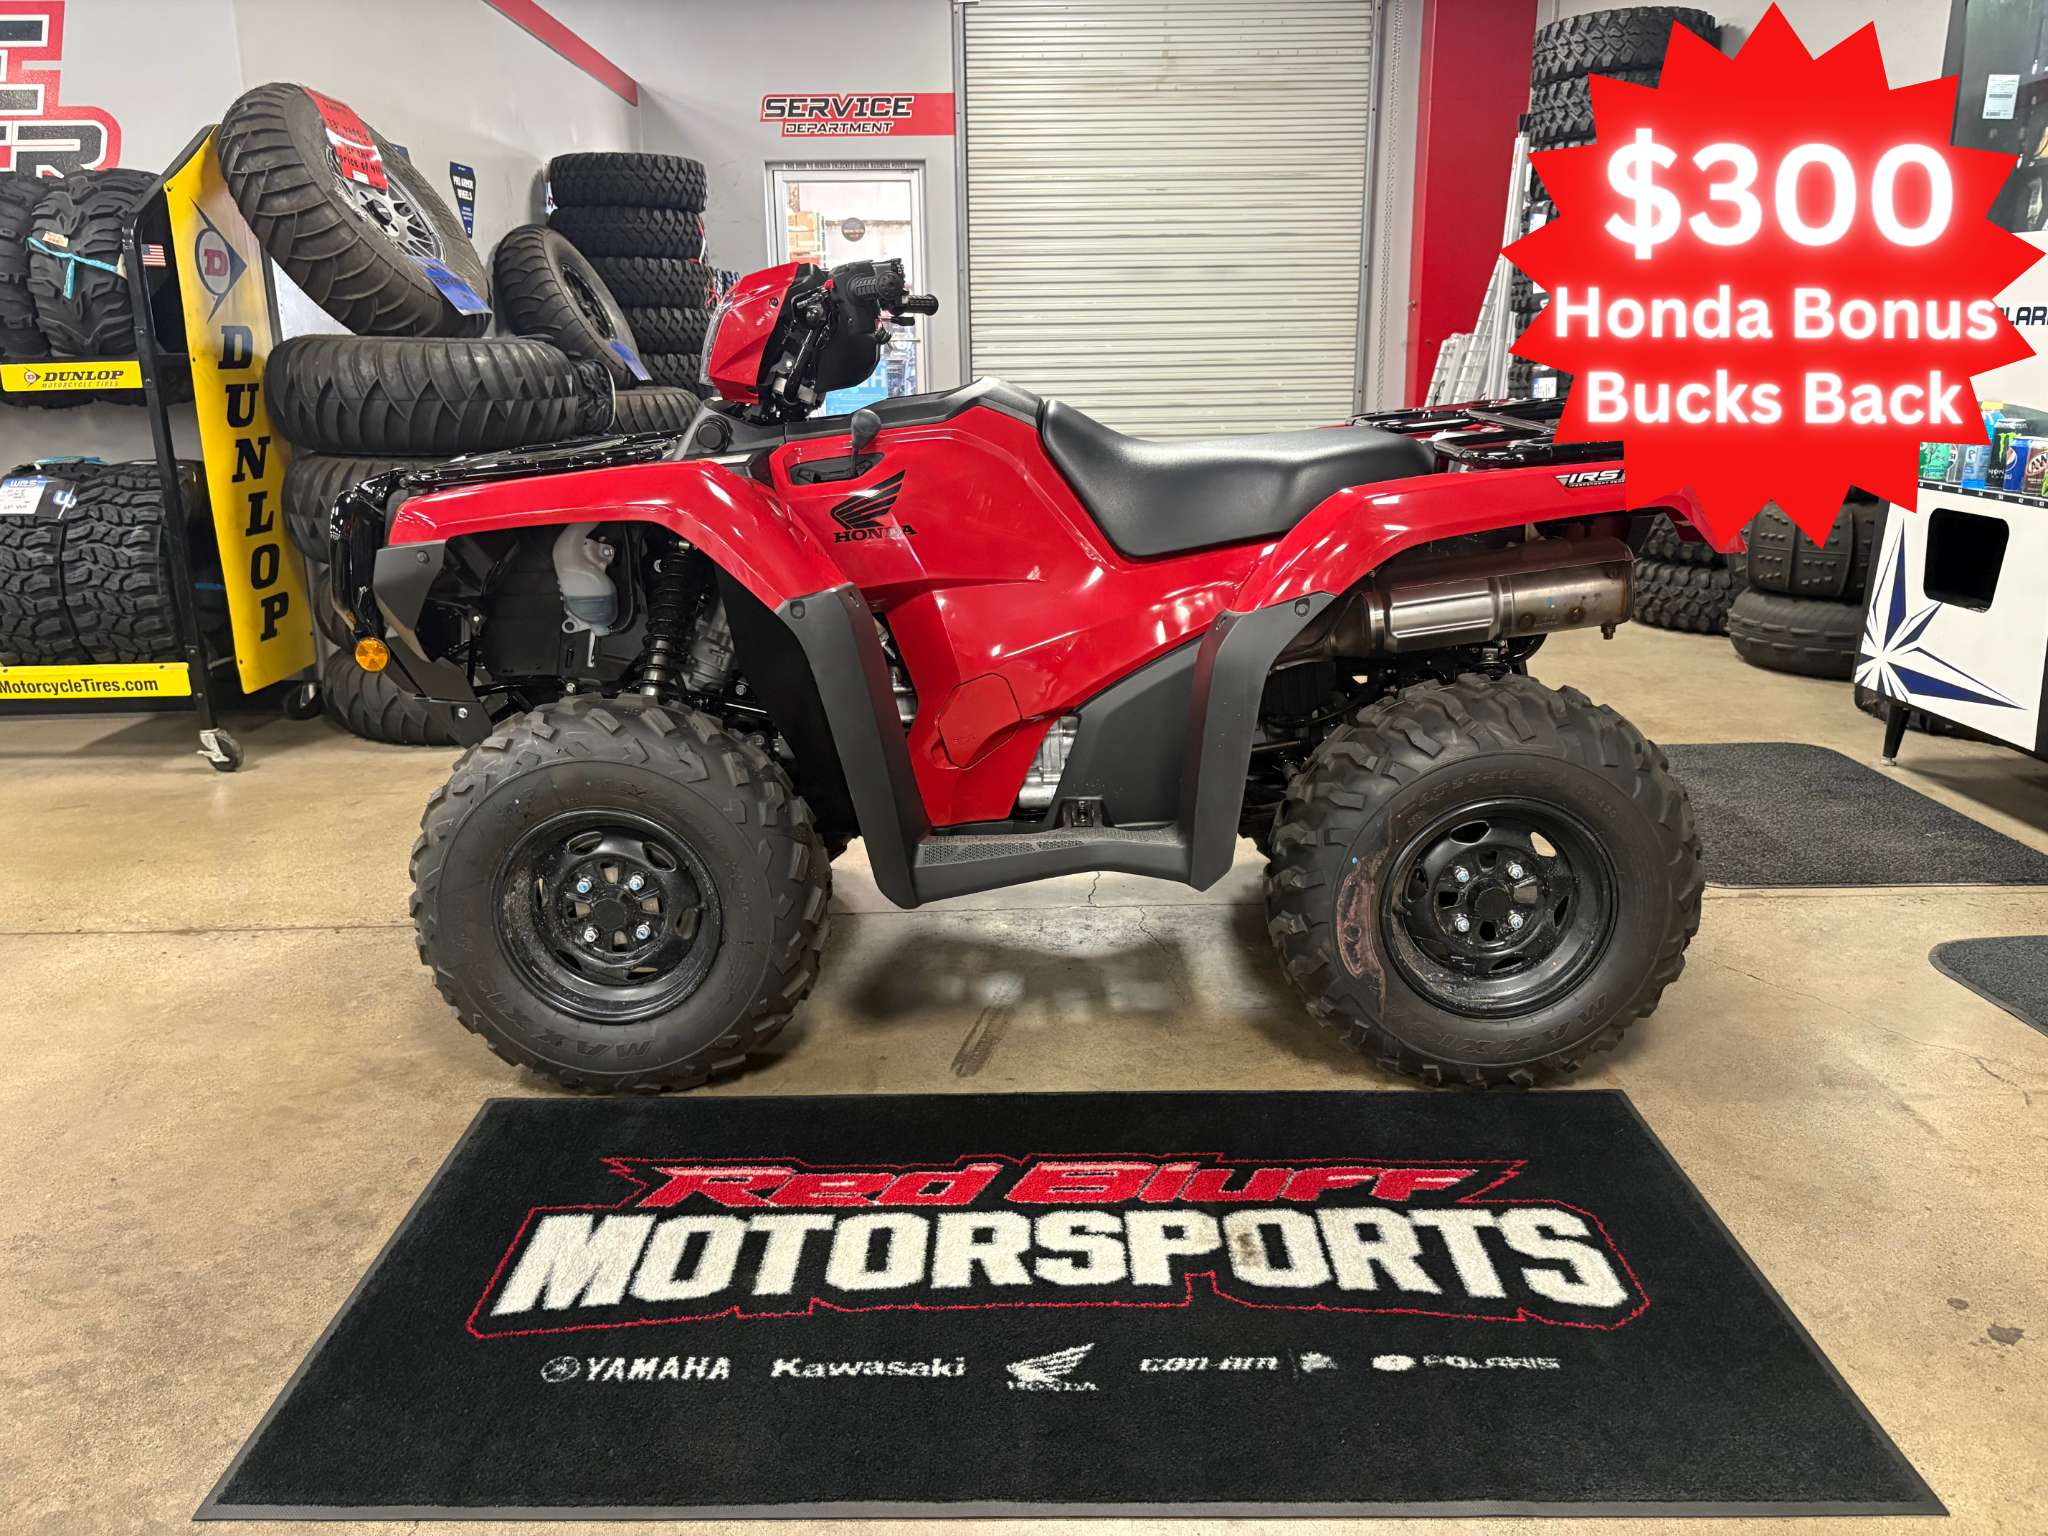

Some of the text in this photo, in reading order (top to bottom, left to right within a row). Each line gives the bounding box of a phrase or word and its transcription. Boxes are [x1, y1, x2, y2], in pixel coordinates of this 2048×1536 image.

[763, 96, 914, 119] SERVICE
[784, 121, 894, 135] DEPARTMENT
[43, 371, 124, 382] DUNLOP
[217, 325, 289, 643] DUNLOP
[1569, 469, 1621, 483] IRS
[833, 525, 917, 543] HONDA
[468, 968, 653, 1061] MAXXIS
[1408, 991, 1608, 1056] MAXXIS
[636, 1163, 1001, 1207] Red
[490, 1207, 1628, 1308] MOTORSPORTS
[586, 1356, 731, 1382] YAMAHA
[770, 1356, 966, 1378] Kawasaki
[1423, 1355, 1560, 1369] POLARIS
